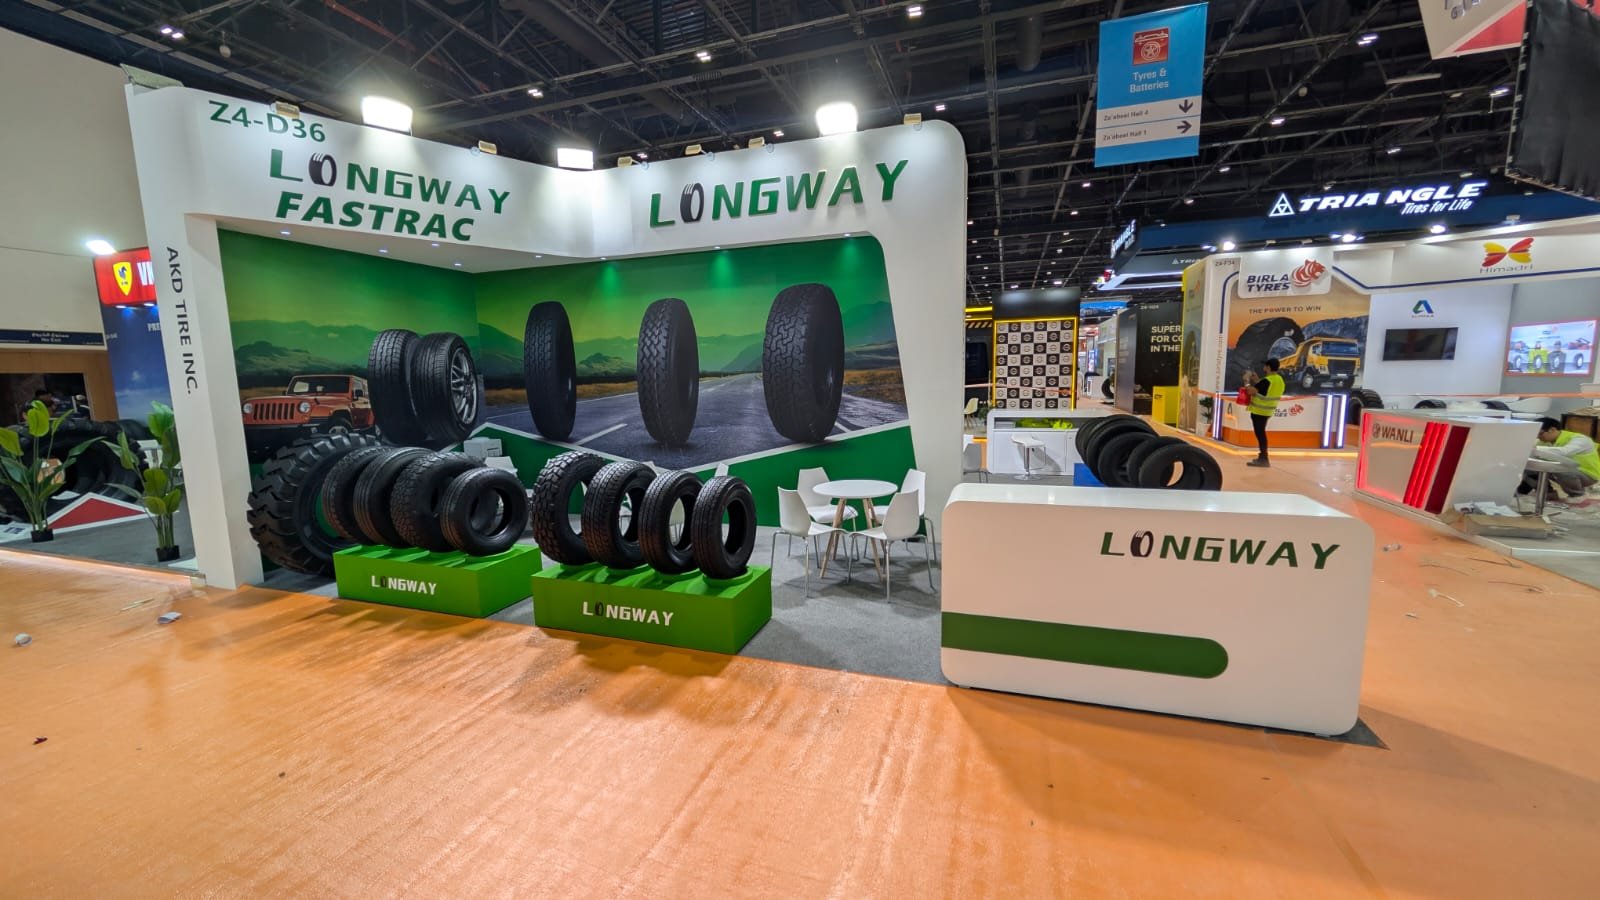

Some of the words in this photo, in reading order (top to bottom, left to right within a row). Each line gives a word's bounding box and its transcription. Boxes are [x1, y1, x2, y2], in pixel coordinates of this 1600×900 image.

[1133, 70, 1157, 82] Tyres
[1159, 68, 1167, 77] &
[1129, 80, 1169, 93] Batteries
[208, 100, 326, 142] Z4-D36
[1130, 110, 1143, 118] Hall
[269, 148, 511, 214] LONGWAY
[649, 159, 909, 228] LONGWAY
[1299, 182, 1488, 212] TRIANGLE
[275, 191, 475, 241] FASTRAC
[1401, 202, 1430, 215] Tires
[1429, 200, 1449, 213] for
[1448, 198, 1473, 211] Life
[166, 247, 184, 294] AKD
[1246, 273, 1289, 284] BIRLA
[1479, 263, 1534, 274] Himadri
[1247, 282, 1292, 293] TYRES
[175, 299, 192, 346] TIRE
[1150, 344, 1161, 353] IN
[1162, 344, 1182, 352] THE
[1151, 335, 1170, 343] FOR
[182, 353, 198, 395] INC.
[1382, 425, 1415, 444] WANLI
[1100, 529, 1341, 570] LONGWAY
[370, 575, 437, 596] LONGWAY
[582, 601, 674, 627] LONGWAY
